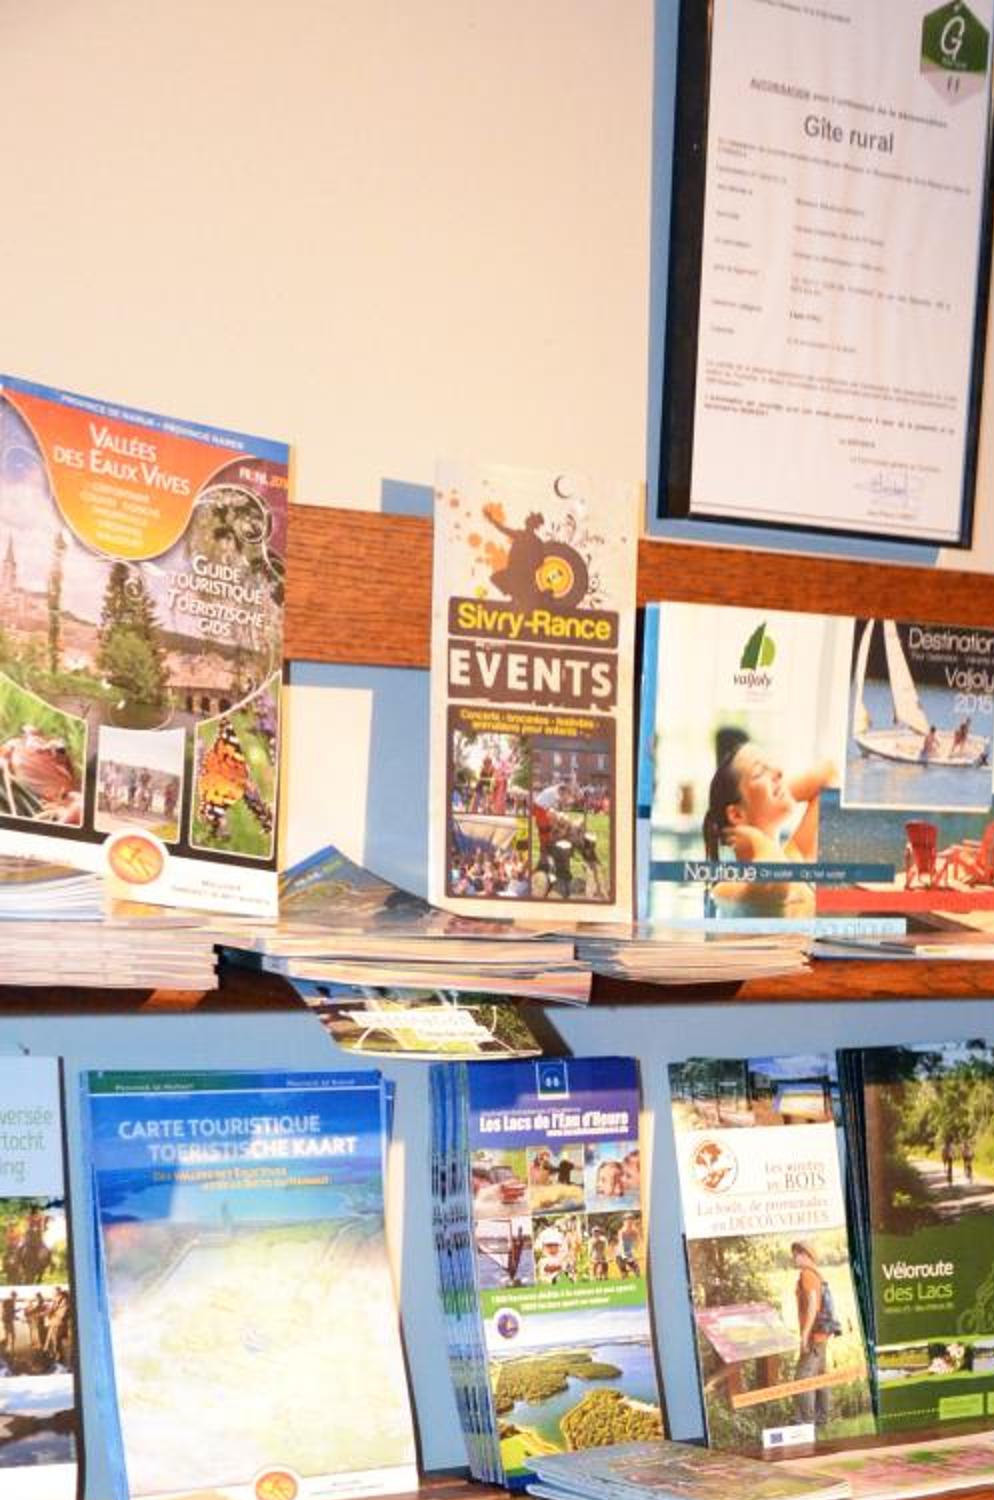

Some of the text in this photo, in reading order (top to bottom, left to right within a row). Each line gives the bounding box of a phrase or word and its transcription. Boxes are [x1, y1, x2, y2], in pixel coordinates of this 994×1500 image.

[849, 129, 895, 154] rural
[457, 602, 612, 641] Sivry-Rance
[450, 648, 613, 698] EVENTS
[683, 863, 757, 883] Nautique
[118, 1114, 322, 1140] CARTE TOURISTIQUE
[480, 1113, 501, 1133] Les
[503, 1112, 531, 1131] Lacs
[148, 1135, 358, 1162] TOERISTISCHE KAART
[882, 1260, 954, 1281] Véloroute
[883, 1281, 954, 1304] des Lacs
